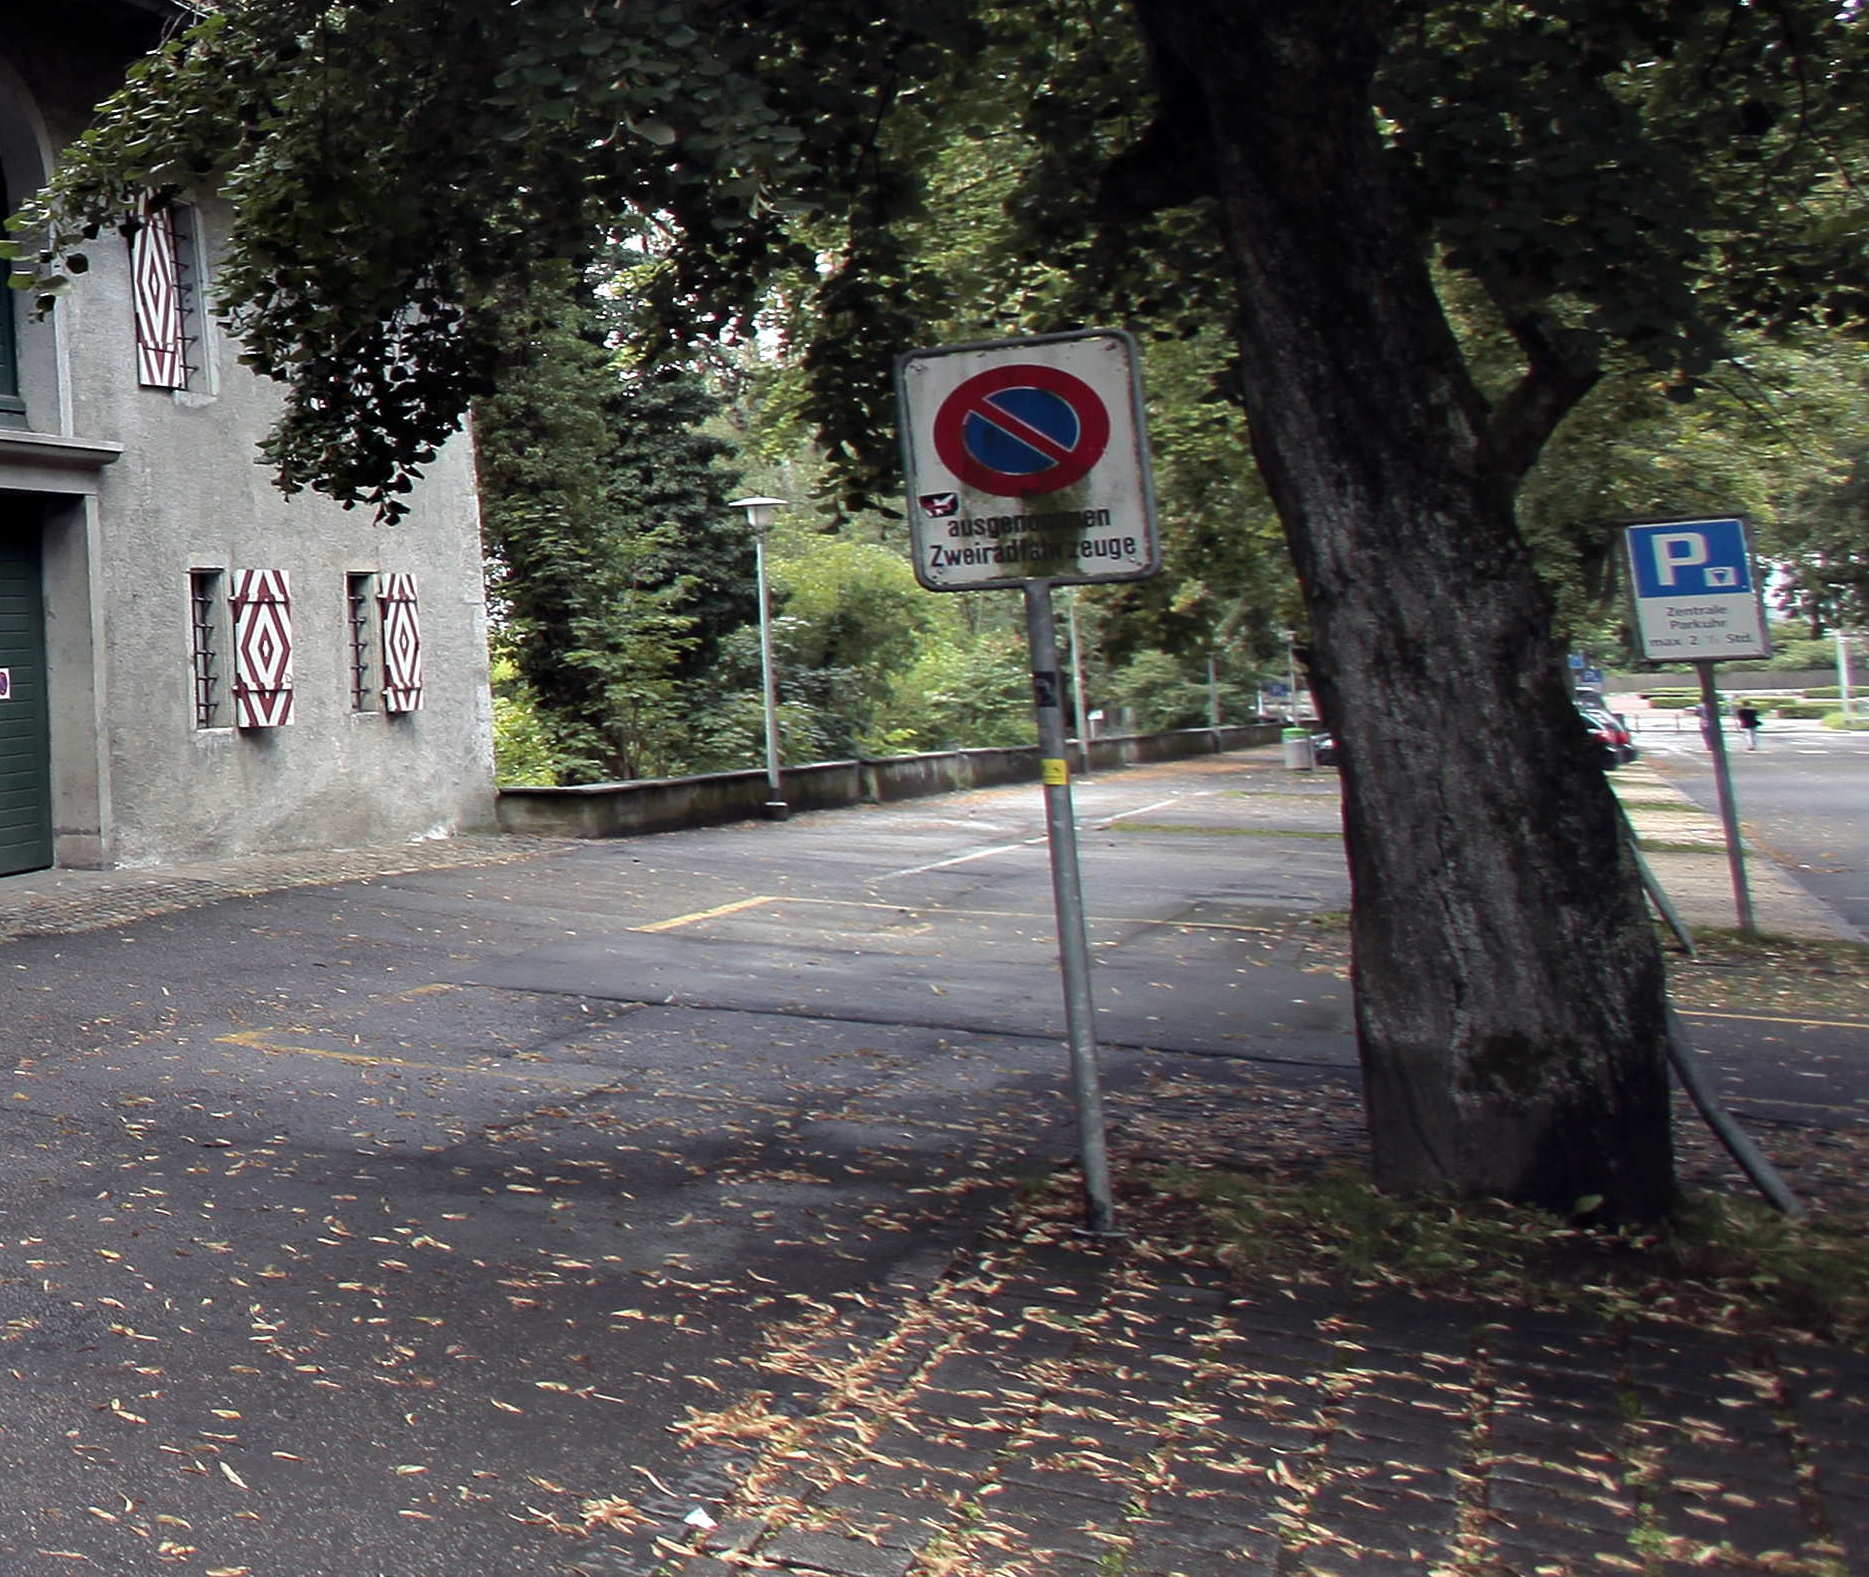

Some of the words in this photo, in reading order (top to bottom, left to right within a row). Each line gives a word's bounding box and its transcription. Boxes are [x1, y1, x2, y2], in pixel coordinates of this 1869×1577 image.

[930, 536, 1136, 567] Zweiradfahrzeuge
[1650, 531, 1709, 587] P
[1666, 604, 1728, 617] Zentrale
[1670, 619, 1726, 630] Parkuhr
[1649, 637, 1682, 647] max
[1689, 635, 1698, 645] 2
[1726, 632, 1755, 644] Std.
